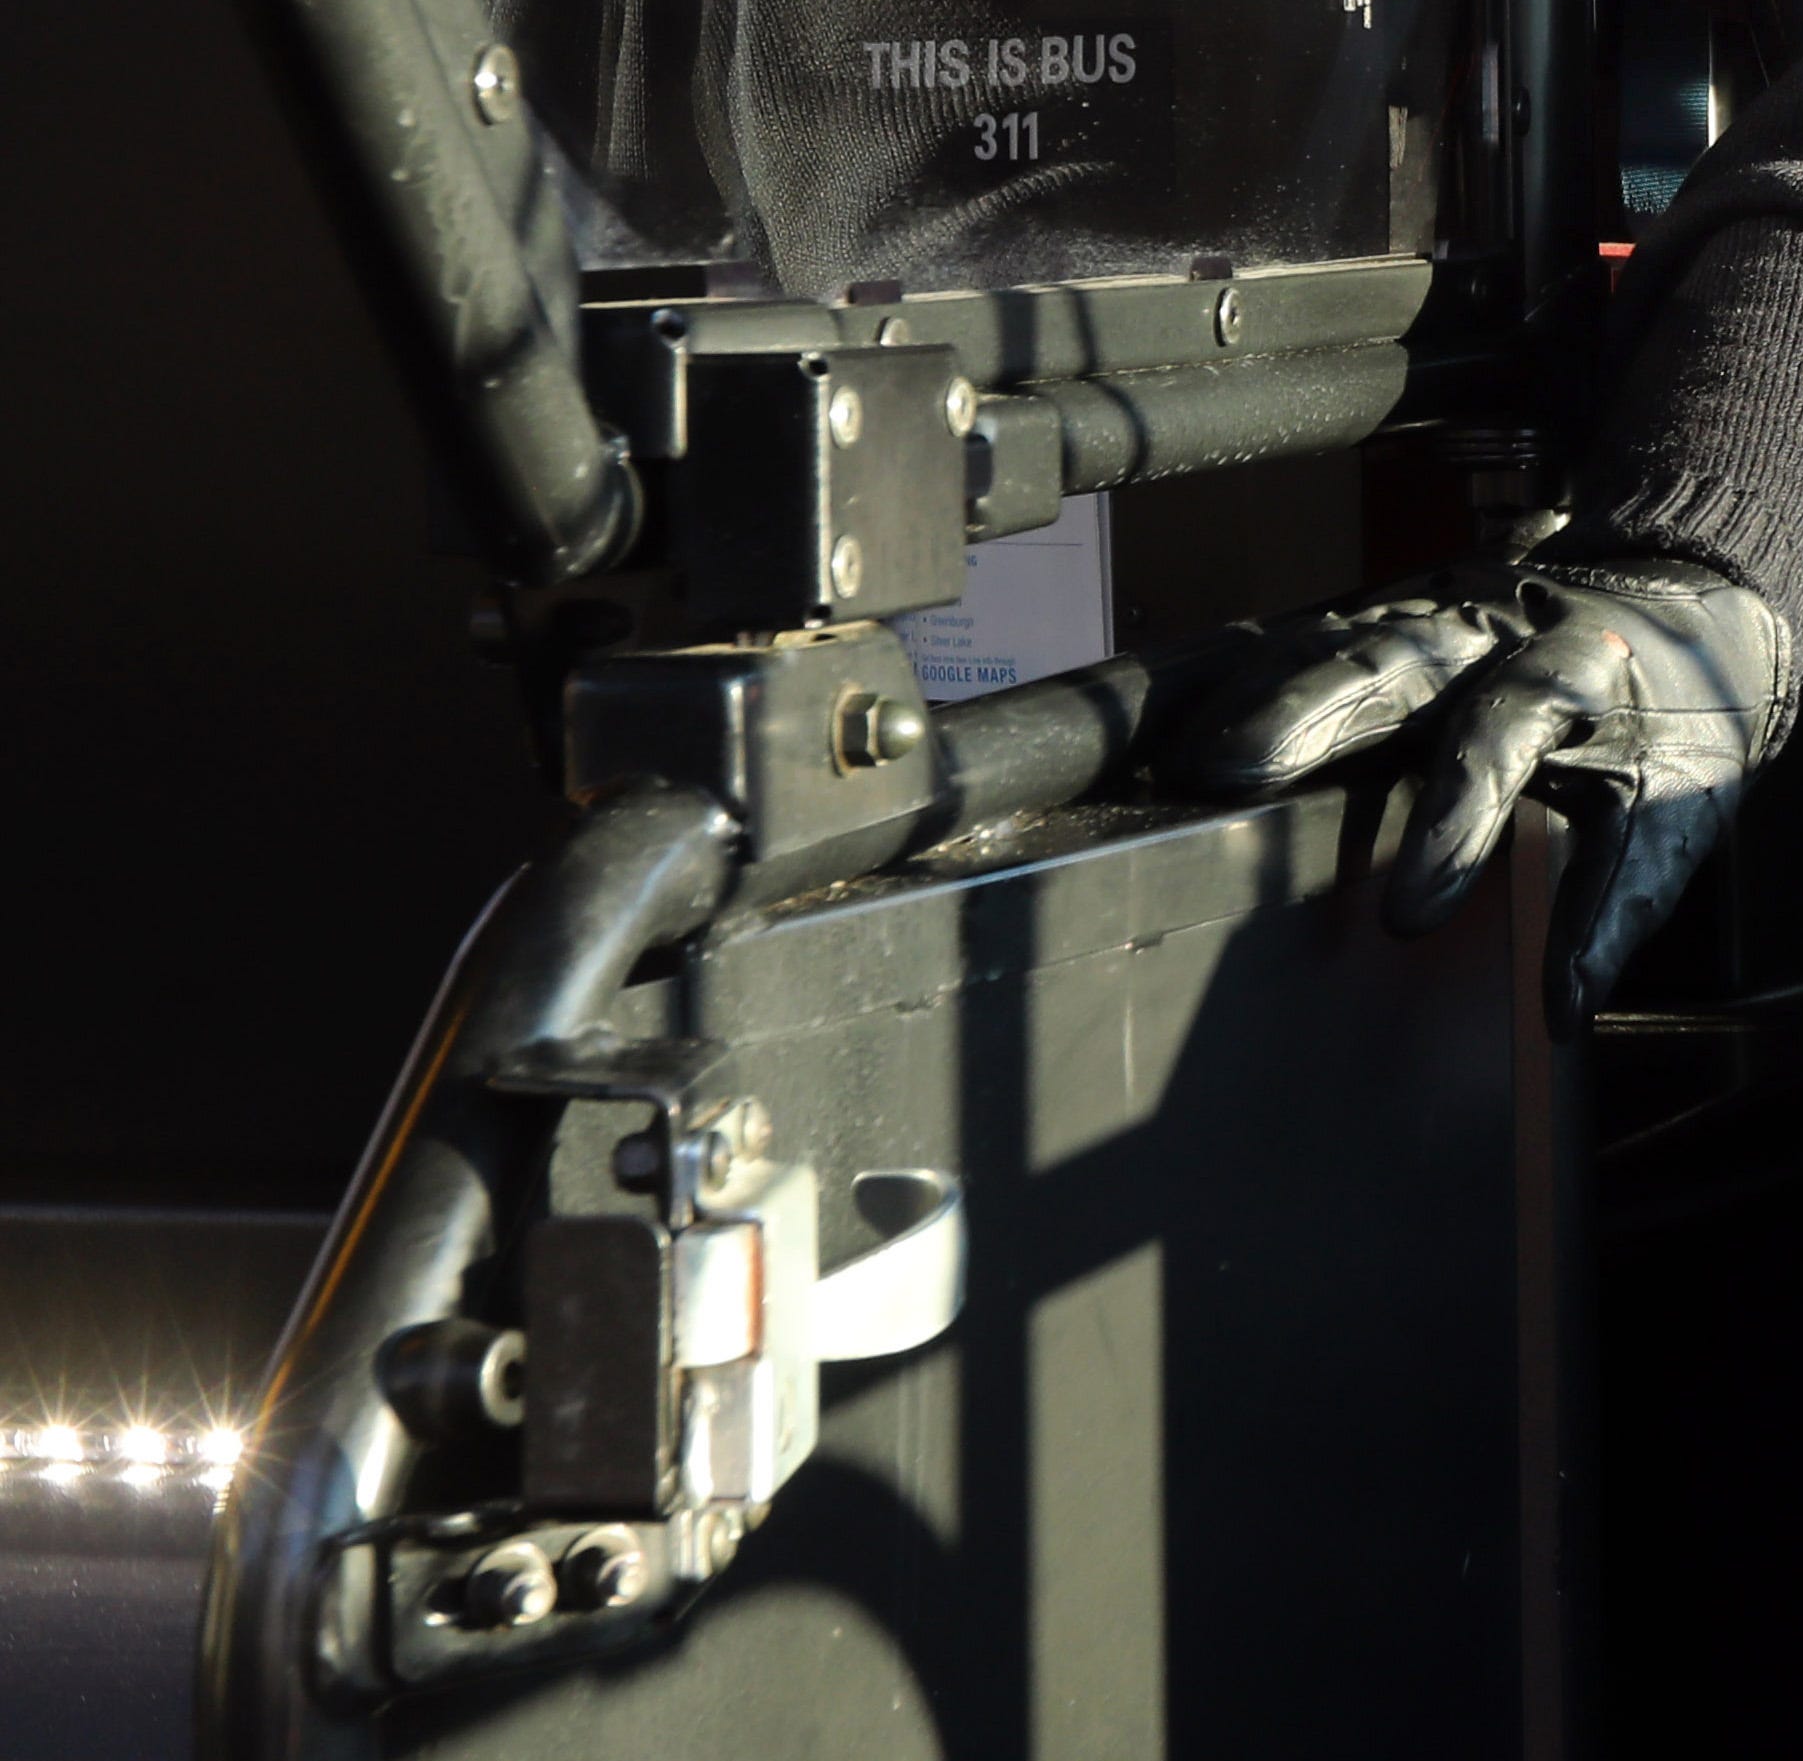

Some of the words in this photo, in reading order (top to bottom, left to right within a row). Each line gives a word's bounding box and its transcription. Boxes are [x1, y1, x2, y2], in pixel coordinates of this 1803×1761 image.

[862, 38, 971, 90] THIS
[987, 37, 1027, 88] IS
[1040, 33, 1137, 85] BUS
[972, 111, 1039, 161] 311
[922, 665, 971, 683] GOOGLE
[977, 667, 1017, 685] MAPS
